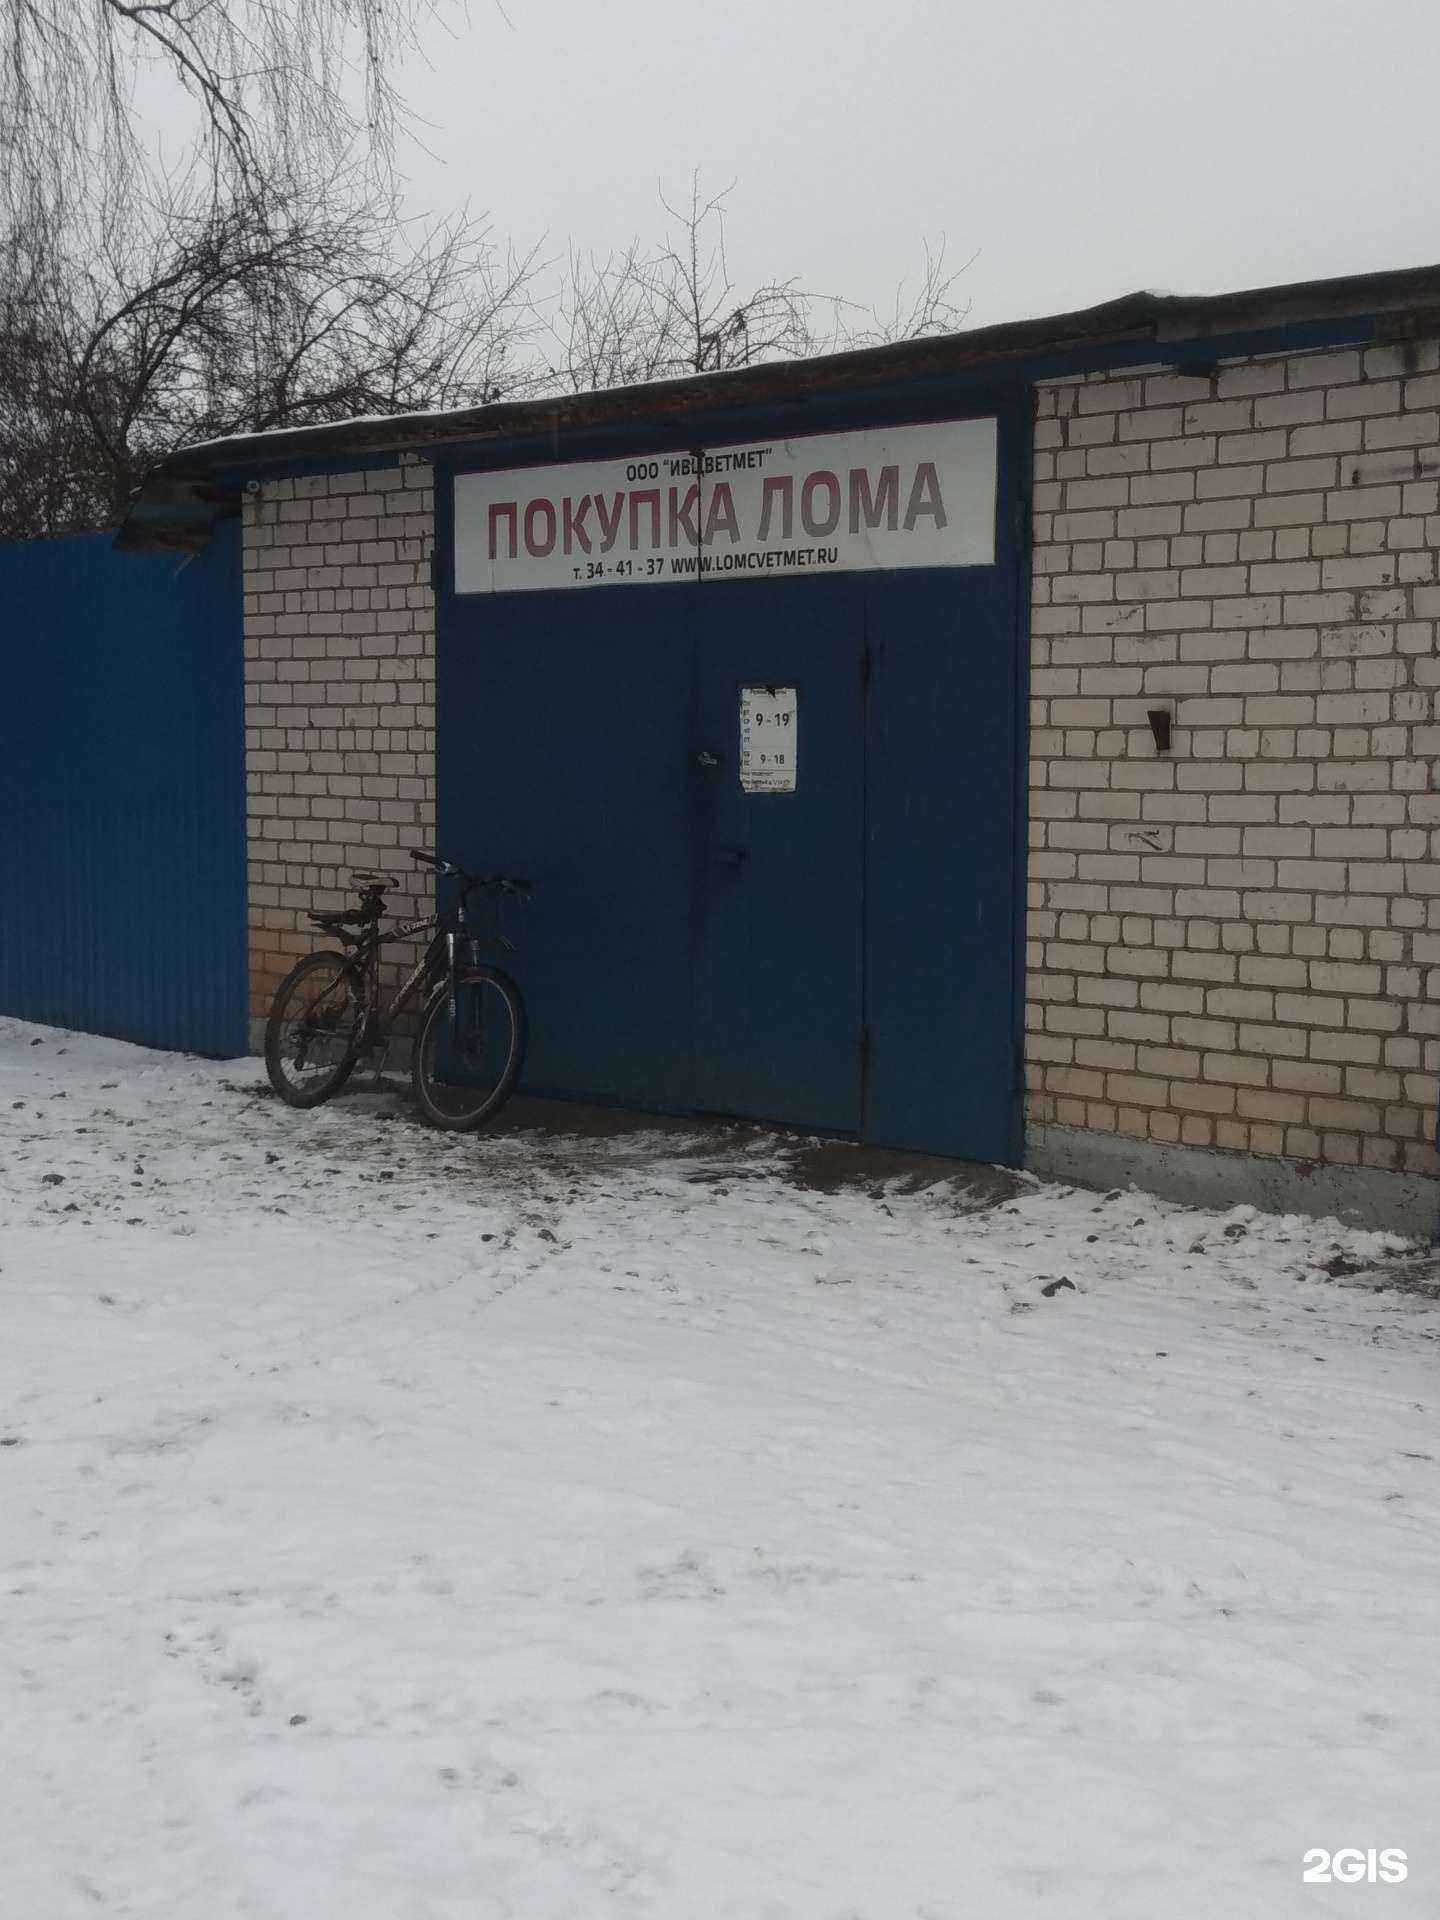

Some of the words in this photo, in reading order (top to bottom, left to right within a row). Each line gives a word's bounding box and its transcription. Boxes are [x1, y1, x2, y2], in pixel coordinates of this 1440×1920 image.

[626, 462, 659, 482] ООО
[488, 482, 741, 560] ПОКУПКА
[757, 462, 948, 543] ЛОМА
[670, 547, 839, 574] WWW.LOMCVETMET.RU
